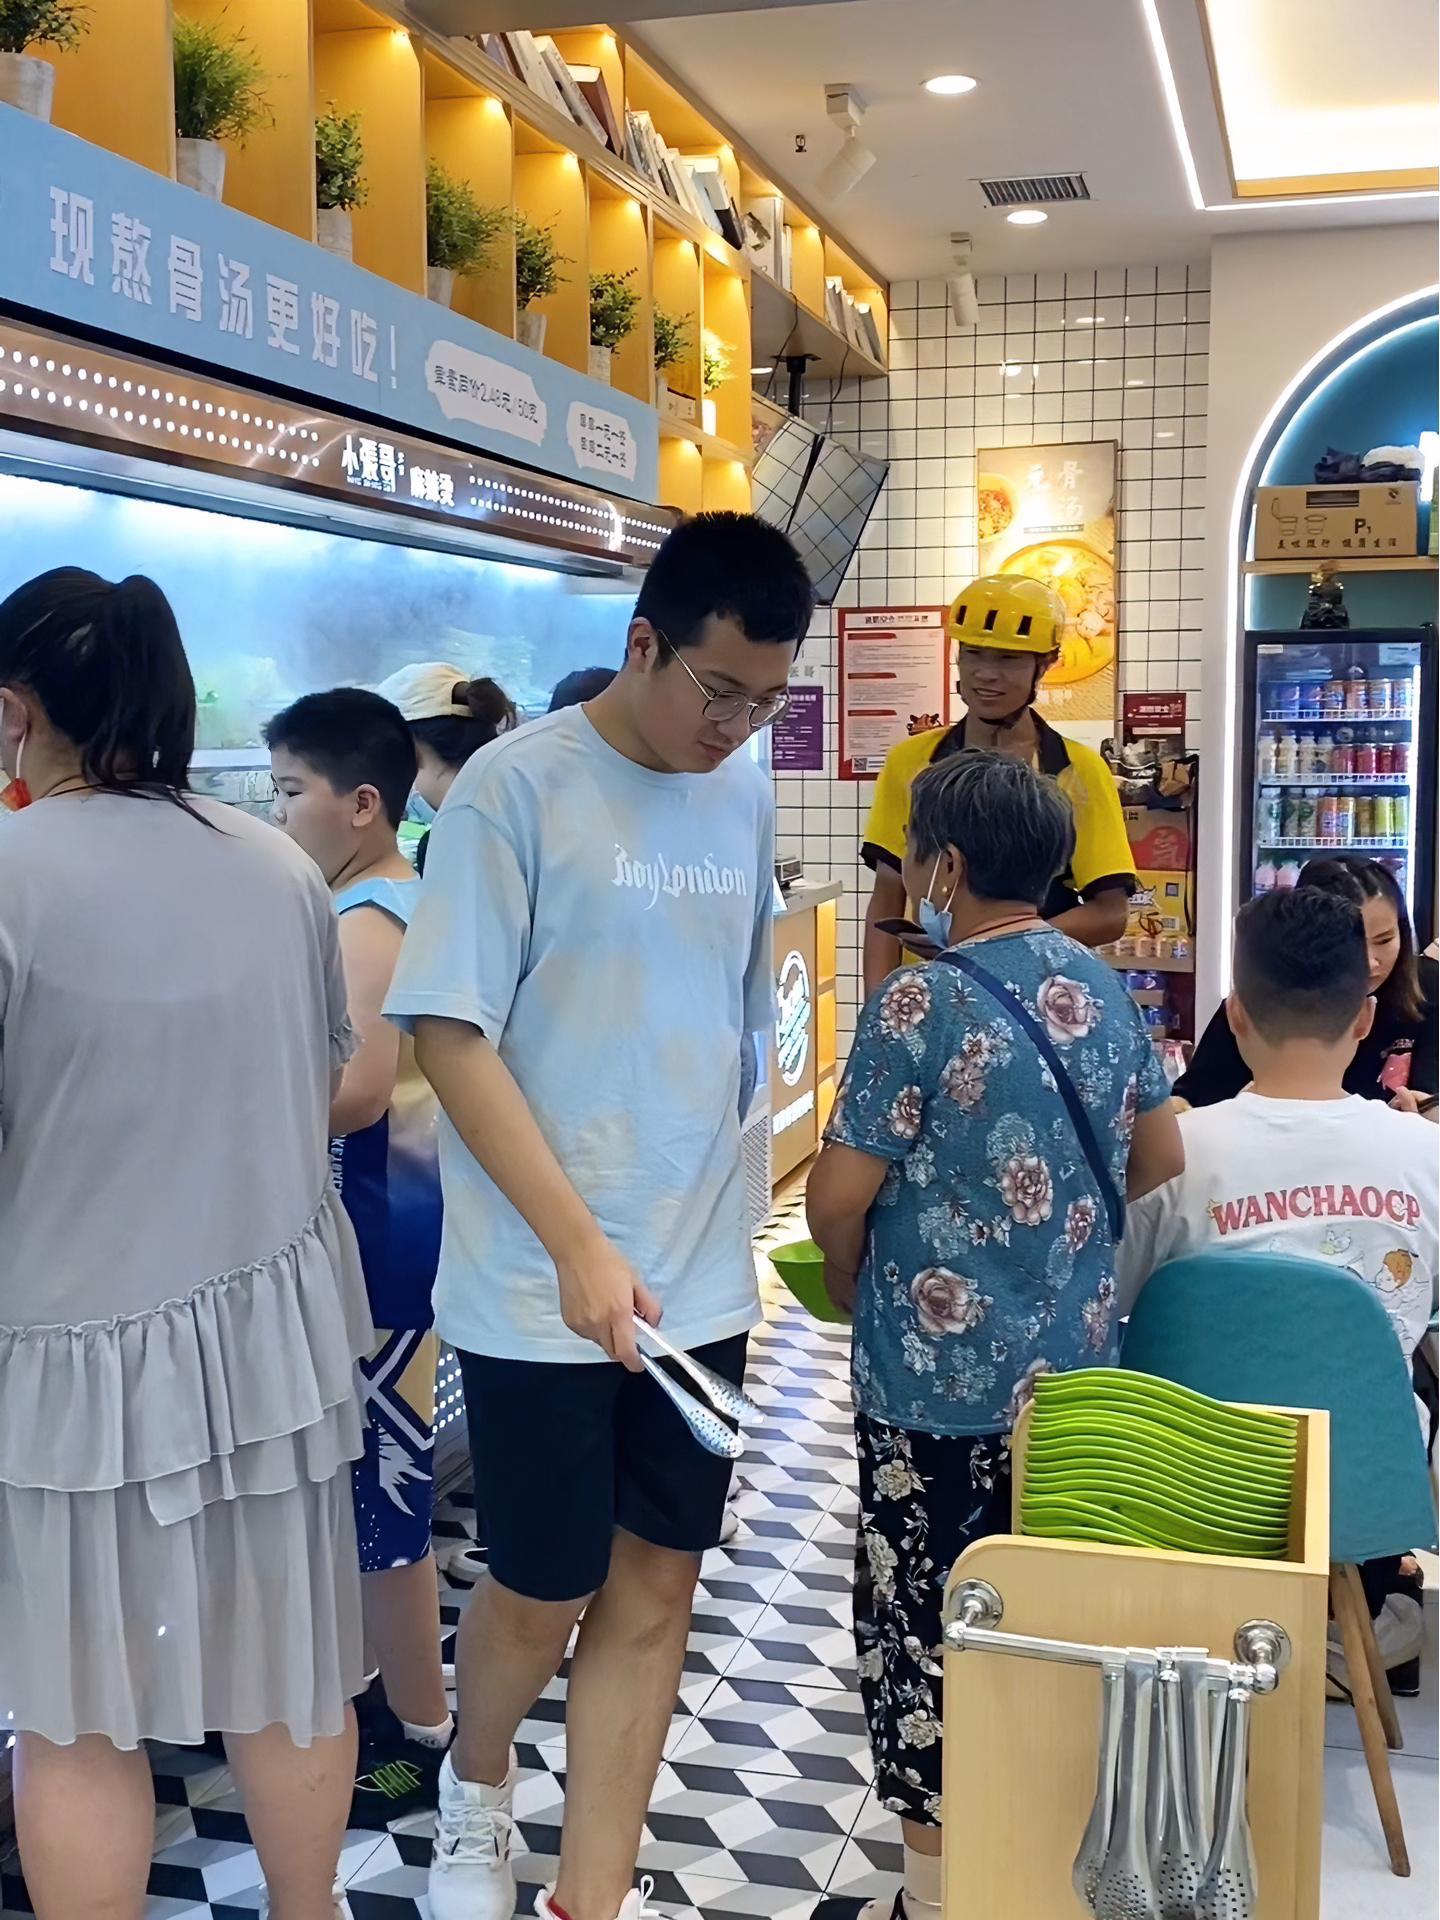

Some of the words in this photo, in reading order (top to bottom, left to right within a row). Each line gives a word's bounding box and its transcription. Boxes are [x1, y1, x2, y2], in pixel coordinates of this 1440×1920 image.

[49, 185, 398, 390] 现熬骨汤更好吃！
